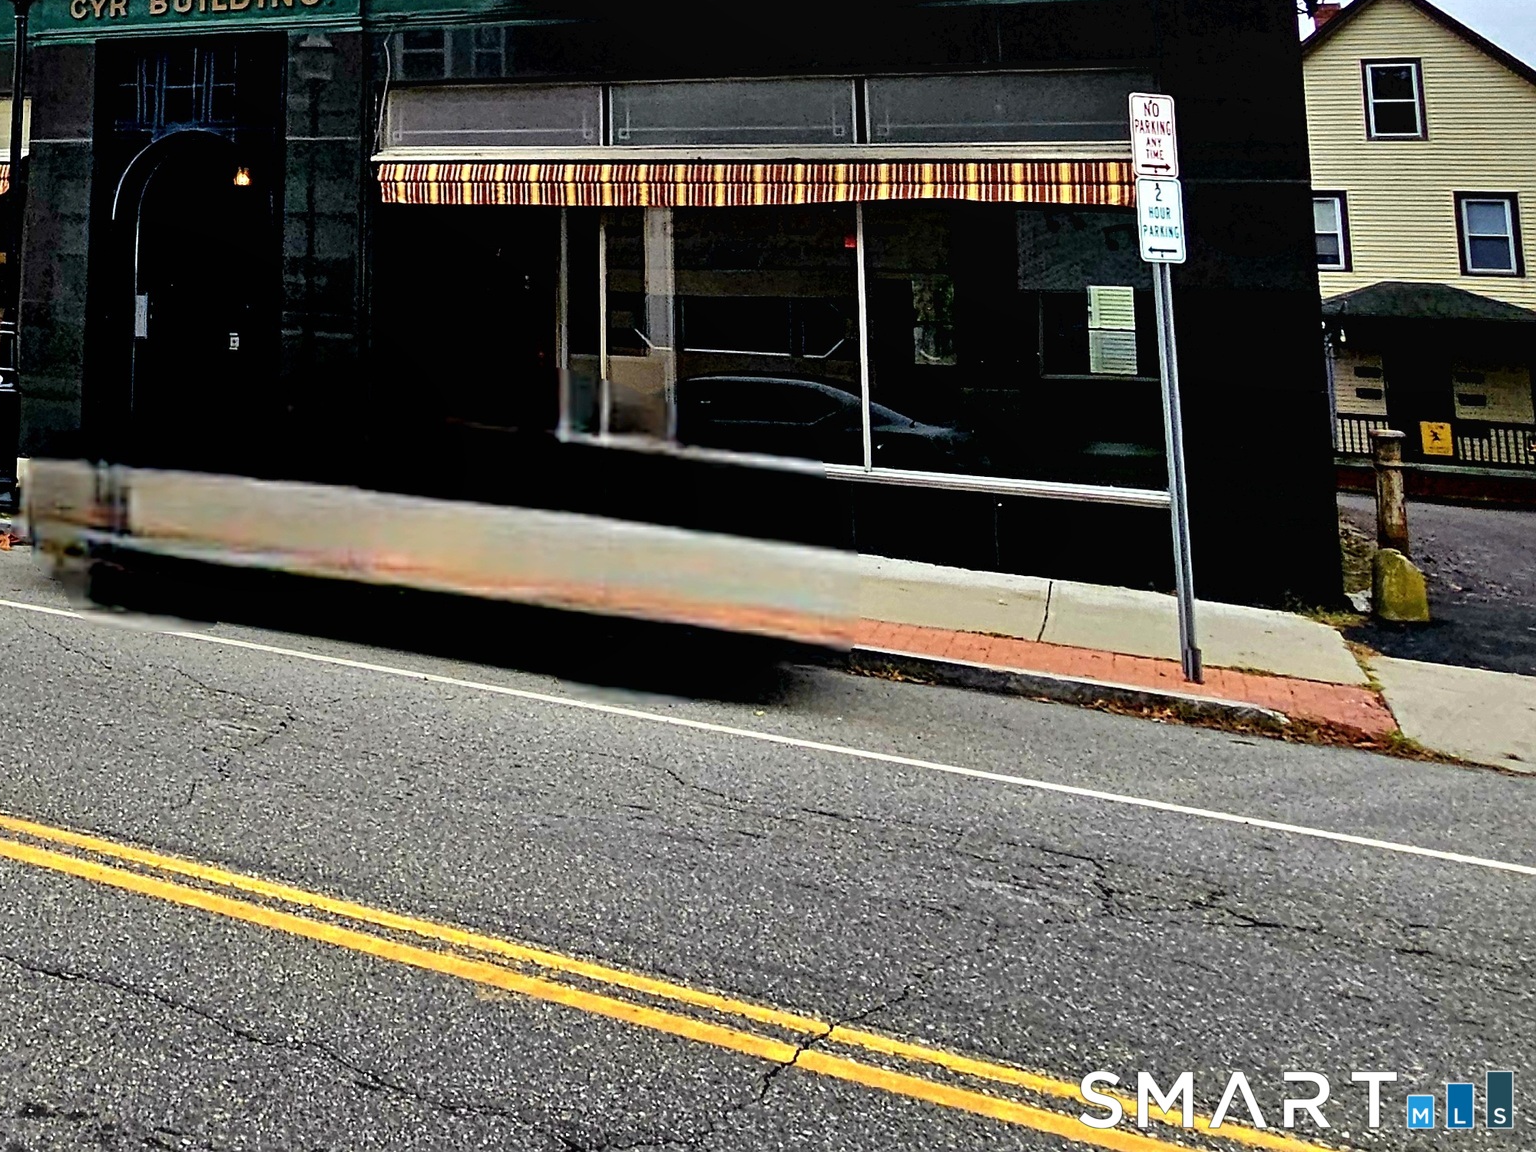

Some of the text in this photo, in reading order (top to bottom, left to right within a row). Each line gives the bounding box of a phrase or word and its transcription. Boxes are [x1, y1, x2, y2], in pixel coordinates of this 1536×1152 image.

[1143, 101, 1160, 118] NO
[1134, 118, 1172, 137] PARKING
[1146, 138, 1162, 148] ANY
[1146, 148, 1165, 161] TIME
[1155, 186, 1163, 202] 2
[1148, 206, 1171, 220] HOUR
[1142, 224, 1180, 239] PARKING
